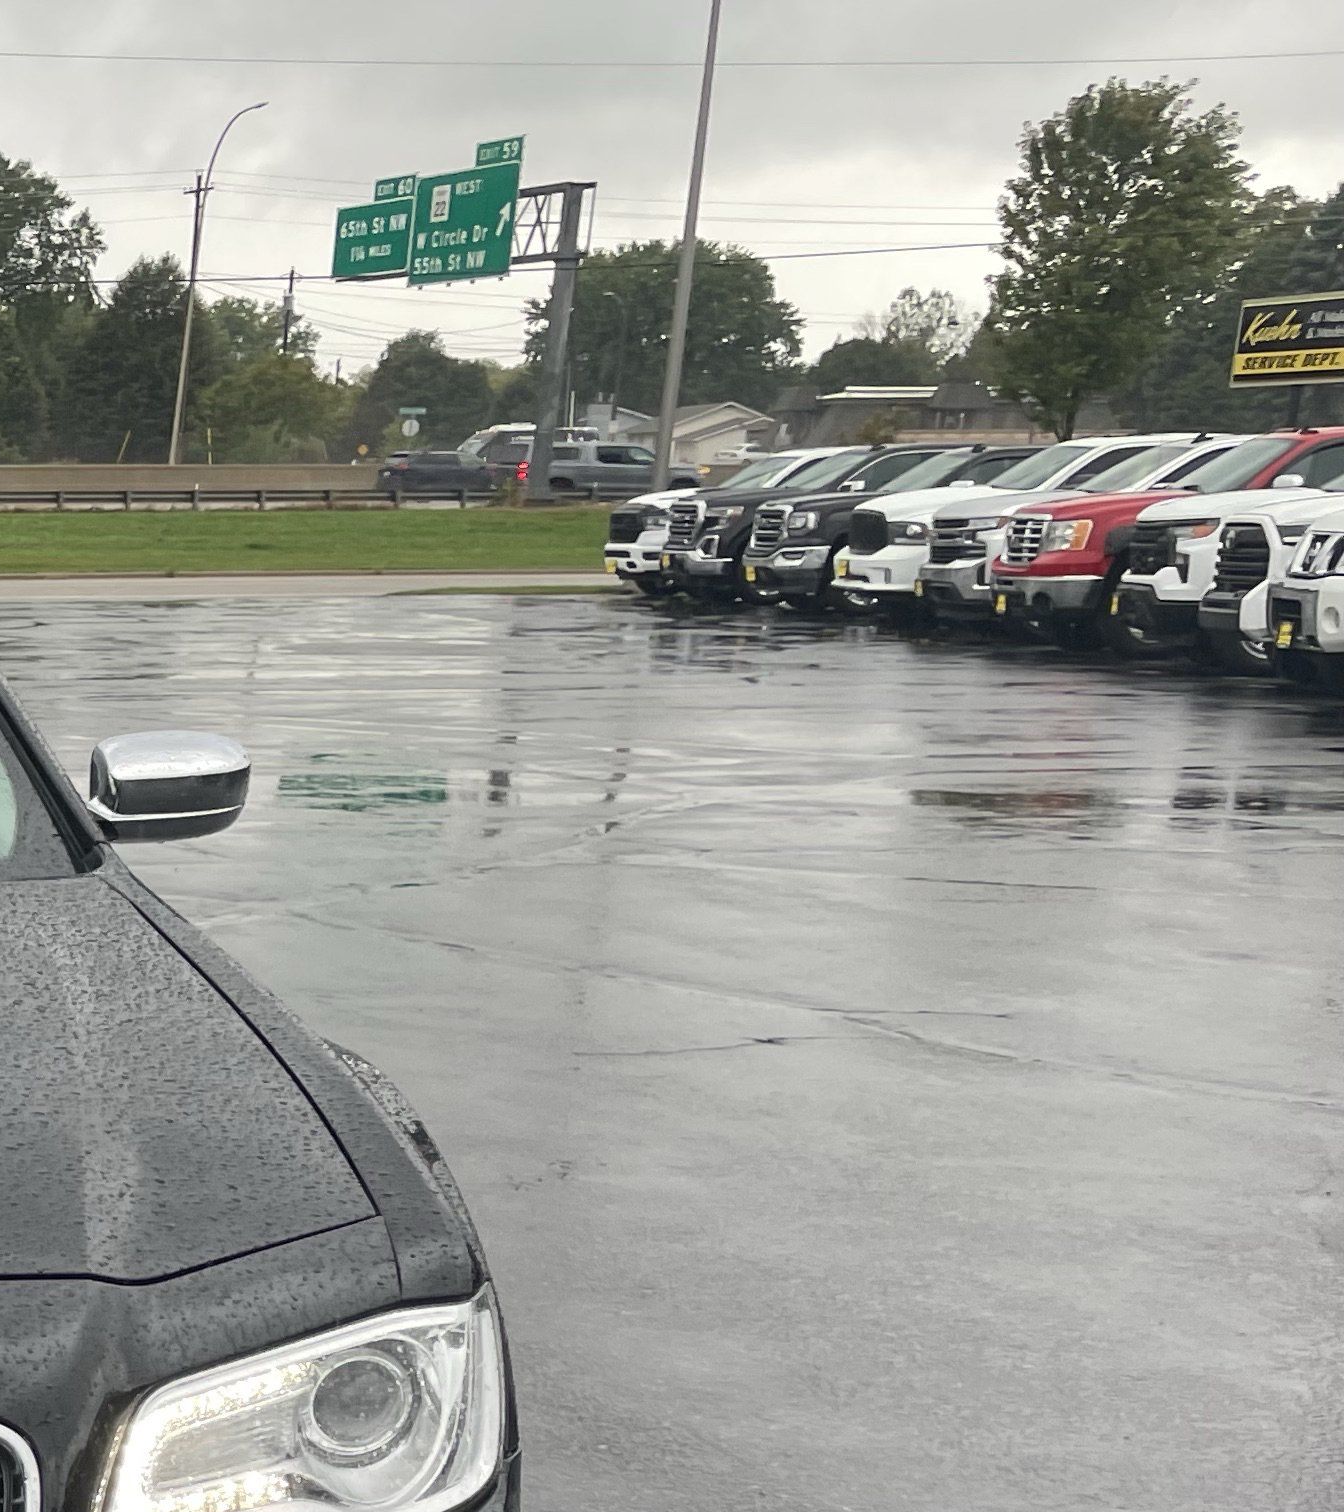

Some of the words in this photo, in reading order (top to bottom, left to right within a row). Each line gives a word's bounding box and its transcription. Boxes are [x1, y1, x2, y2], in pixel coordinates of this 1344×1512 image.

[433, 201, 447, 217] 22
[340, 219, 368, 239] 65th
[372, 216, 385, 235] St
[432, 228, 468, 248] Circle
[472, 224, 488, 243] Dr
[413, 257, 443, 275] 55th
[447, 253, 461, 271] St
[466, 250, 486, 269] NW
